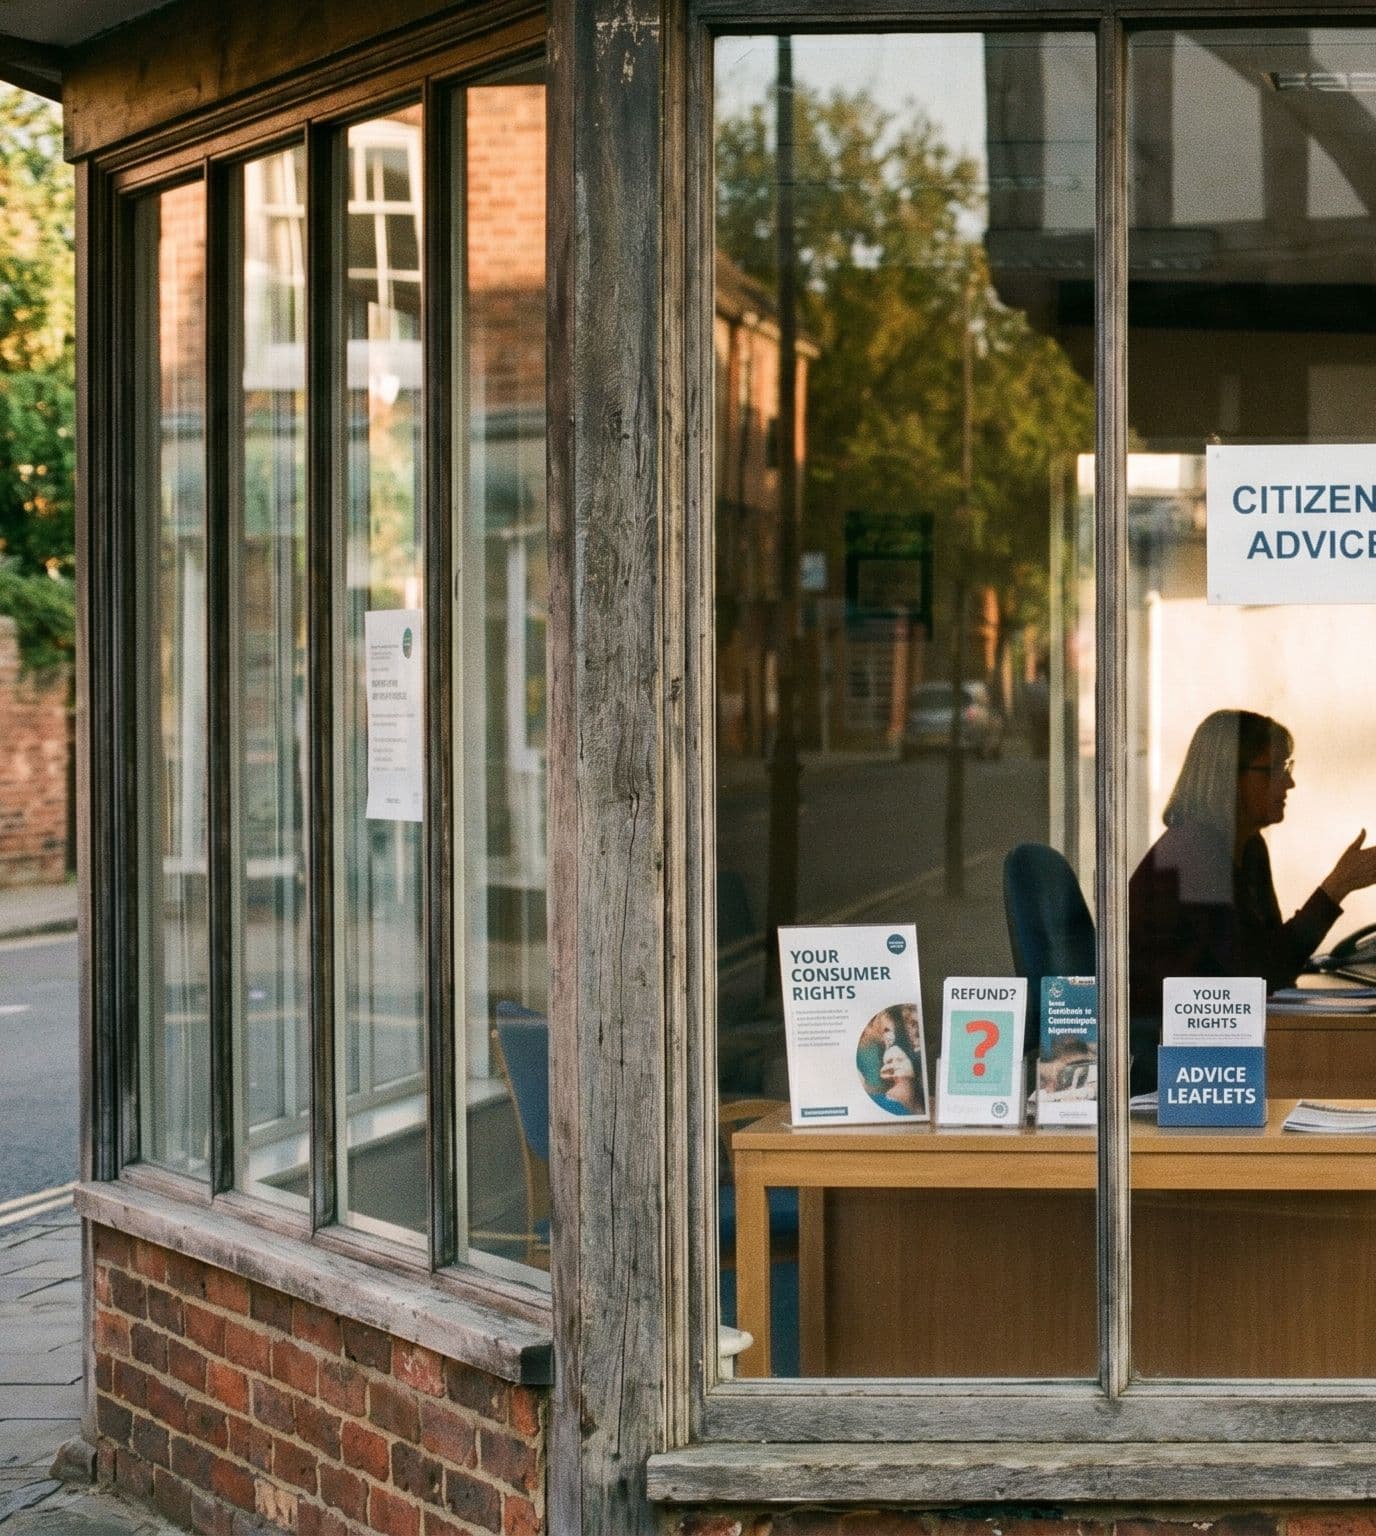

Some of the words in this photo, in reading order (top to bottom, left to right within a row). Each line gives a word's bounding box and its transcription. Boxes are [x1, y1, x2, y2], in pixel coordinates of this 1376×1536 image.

[790, 949, 840, 965] YOUR
[791, 966, 891, 983] CONSUMER
[792, 985, 857, 1001] RIGHTS
[951, 987, 1017, 1001] REFUND?
[1193, 989, 1231, 1001] YOUR
[1174, 1003, 1252, 1015] CONSUMER
[1187, 1018, 1237, 1029] RIGHTS
[966, 1019, 1000, 1077] ?
[1175, 1066, 1247, 1084] ADVICE
[1167, 1087, 1256, 1105] LEAFLETS
